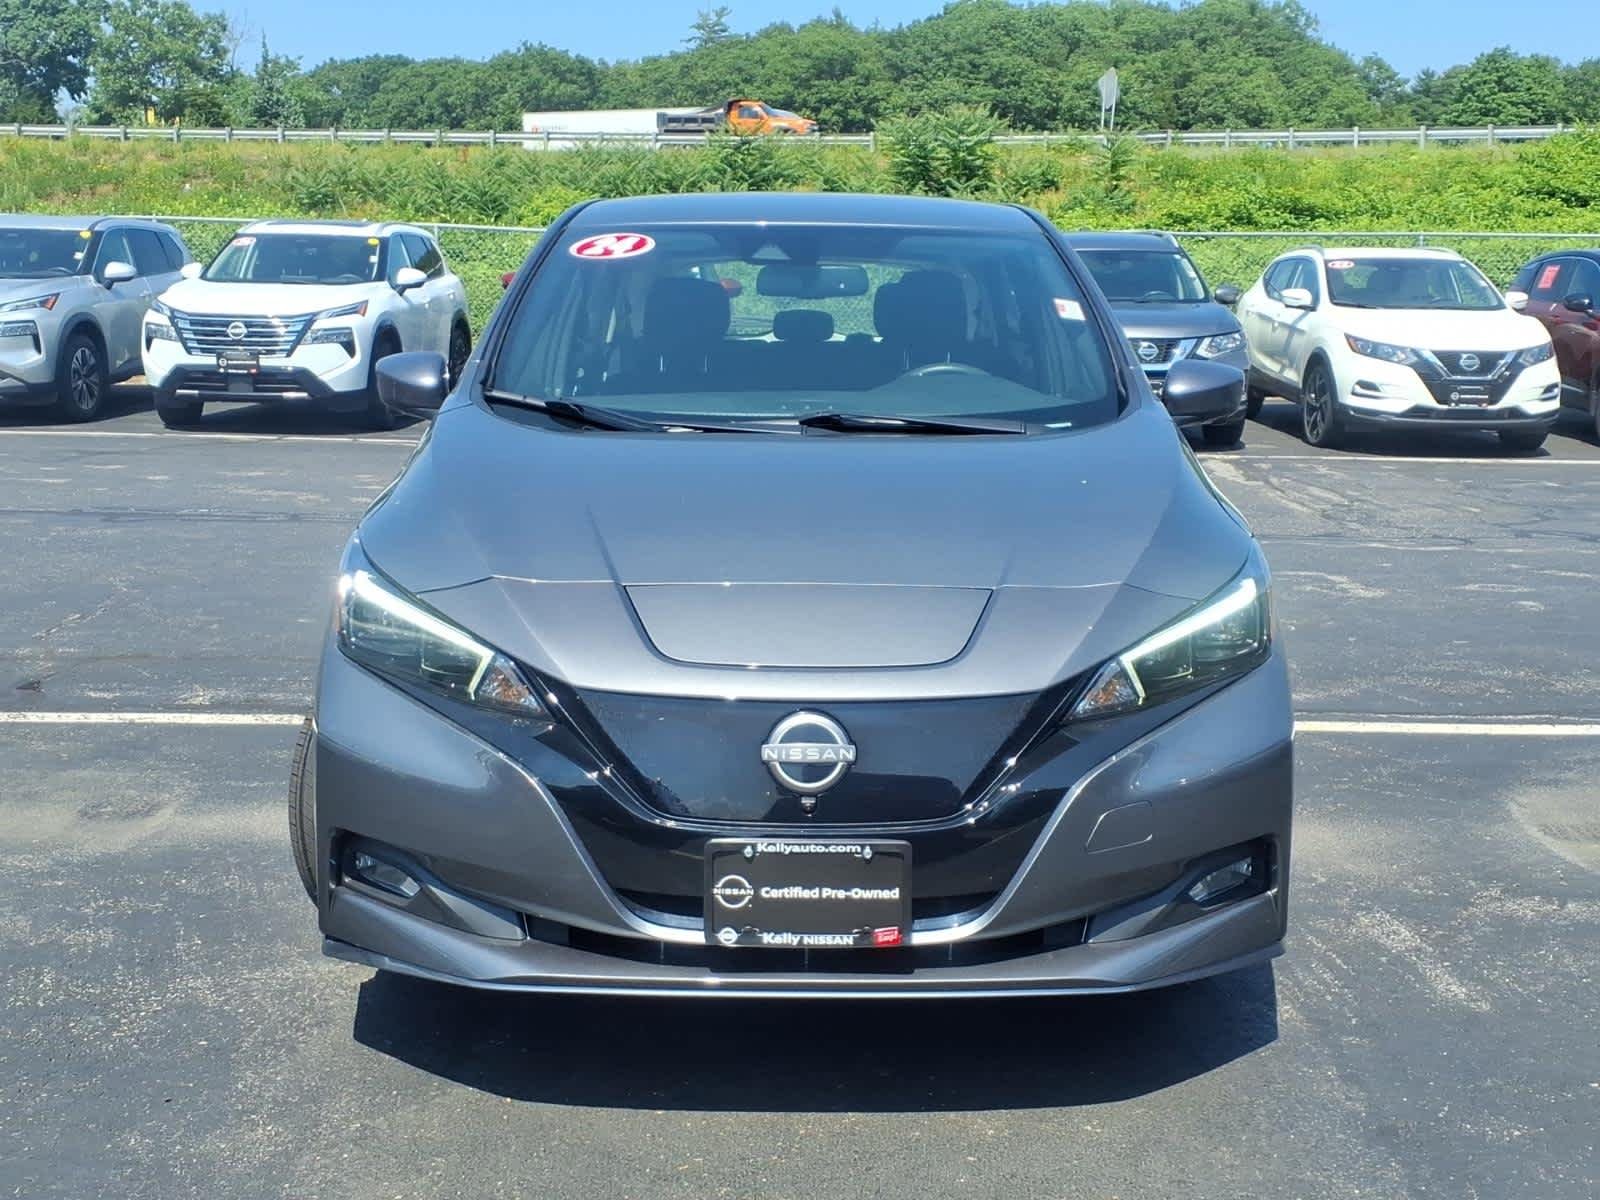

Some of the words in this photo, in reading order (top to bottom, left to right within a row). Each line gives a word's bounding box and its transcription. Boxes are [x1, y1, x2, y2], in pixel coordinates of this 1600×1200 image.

[764, 748, 853, 760] NISSAN
[757, 842, 862, 855] Kellyauto.com
[712, 887, 754, 896] NISSAN
[760, 886, 820, 899] Certified
[821, 887, 900, 900] Pre-Owned
[762, 931, 801, 946] Kelly
[803, 935, 855, 945] NISSAN
